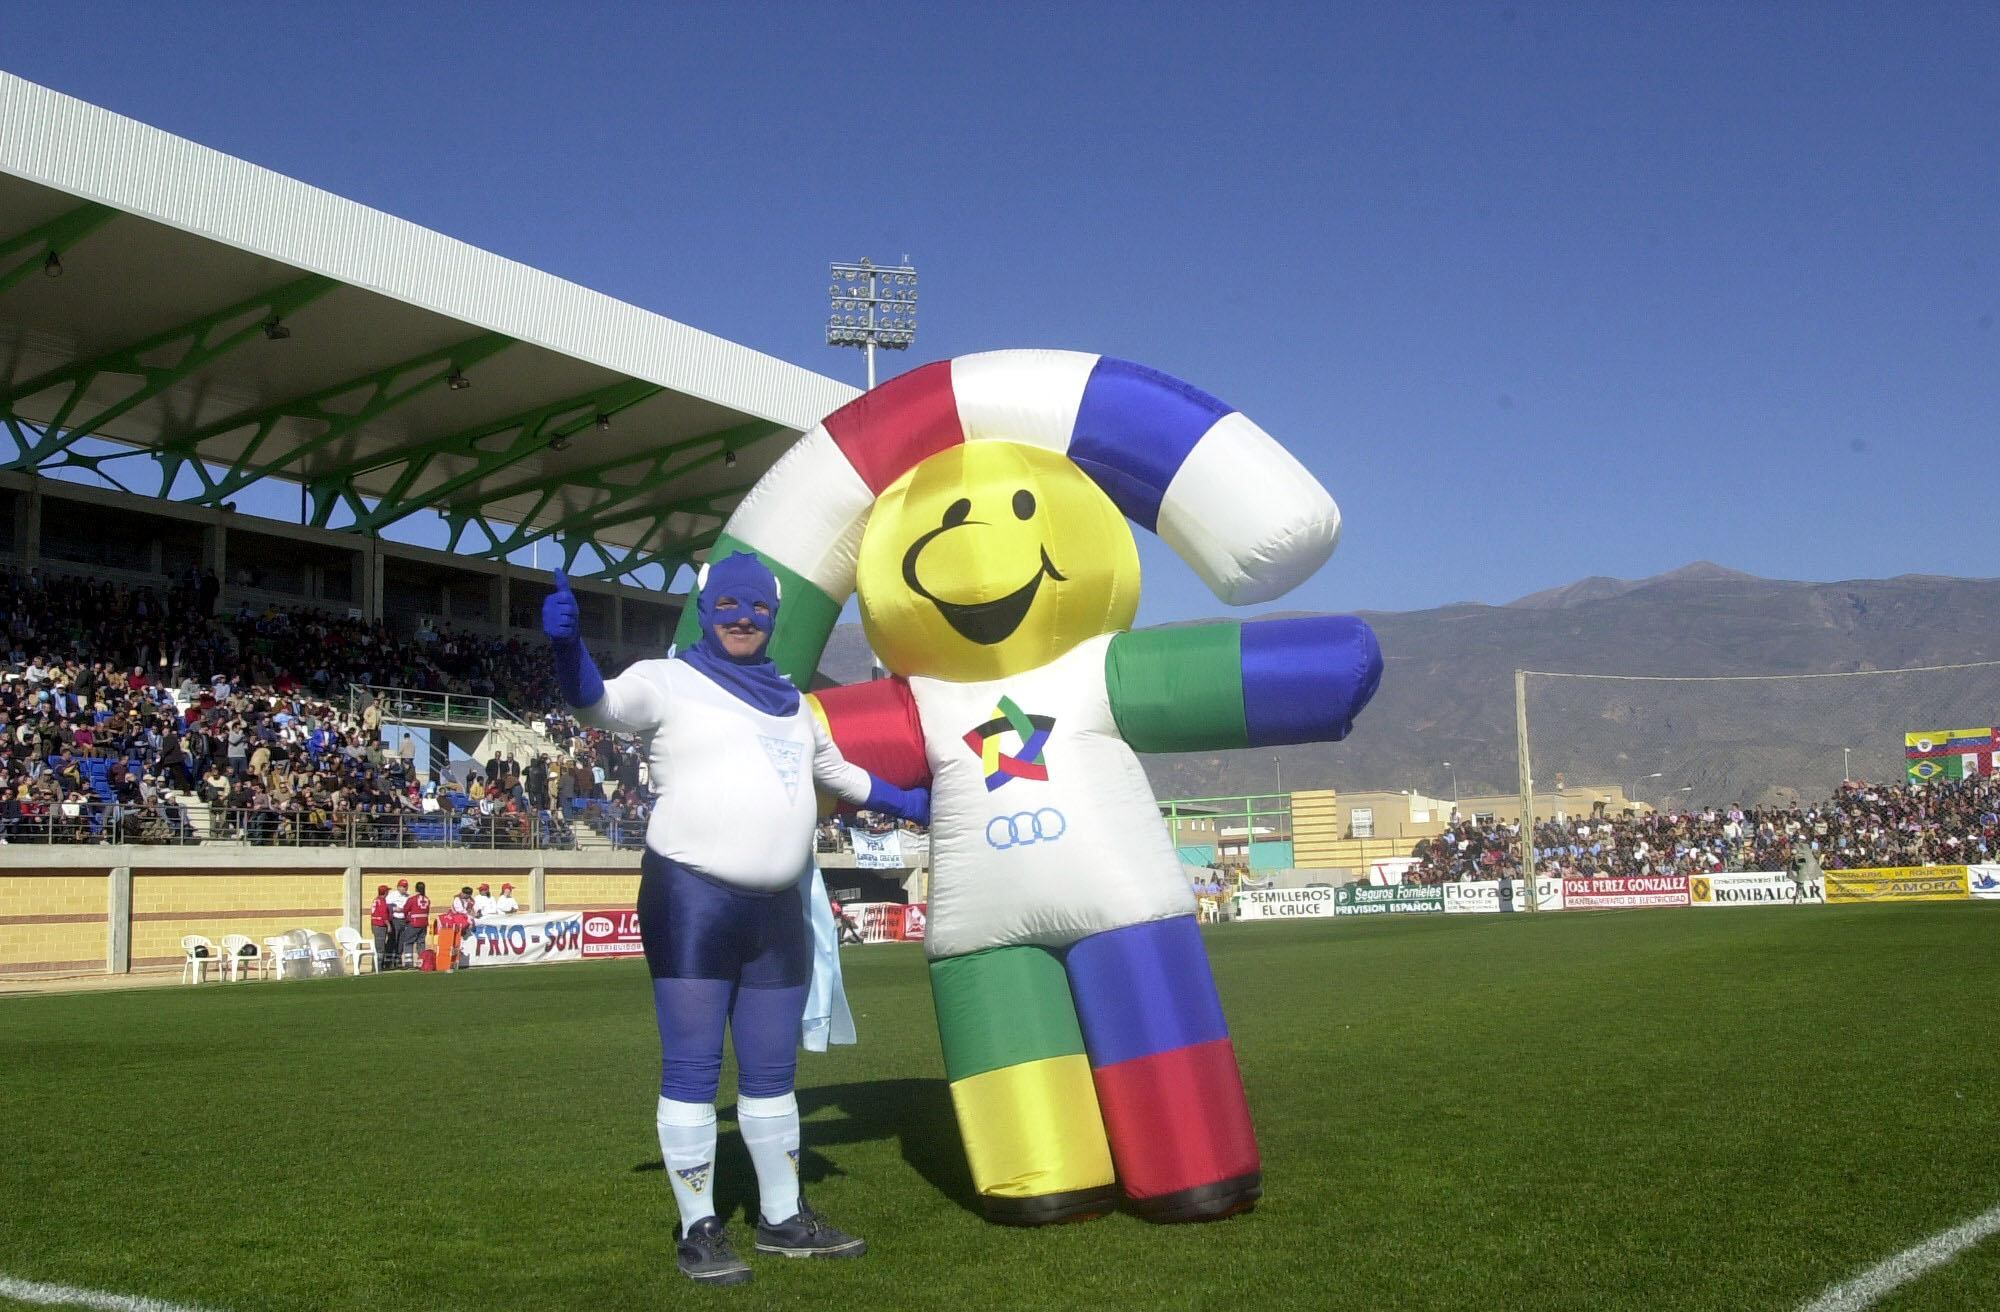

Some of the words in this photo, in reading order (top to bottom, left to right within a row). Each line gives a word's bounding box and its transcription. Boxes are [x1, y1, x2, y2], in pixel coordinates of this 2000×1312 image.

[1446, 881, 1551, 900] Floragad
[1565, 880, 1590, 894] JOSE
[1593, 878, 1625, 892] PEREZ
[1627, 876, 1687, 891] GONZALEZ
[1250, 889, 1331, 903] SEMILLEROS
[1355, 887, 1394, 901] Seguros
[1715, 885, 1822, 902] ROMBALCAR
[1262, 904, 1276, 915] EL
[1279, 903, 1321, 915] CRUCE
[1336, 904, 1386, 915] PREVISION
[1389, 901, 1442, 912] ESPAÑOLA
[588, 921, 610, 933] OTTO
[474, 924, 527, 956] FRIO
[544, 919, 581, 952] SUR
